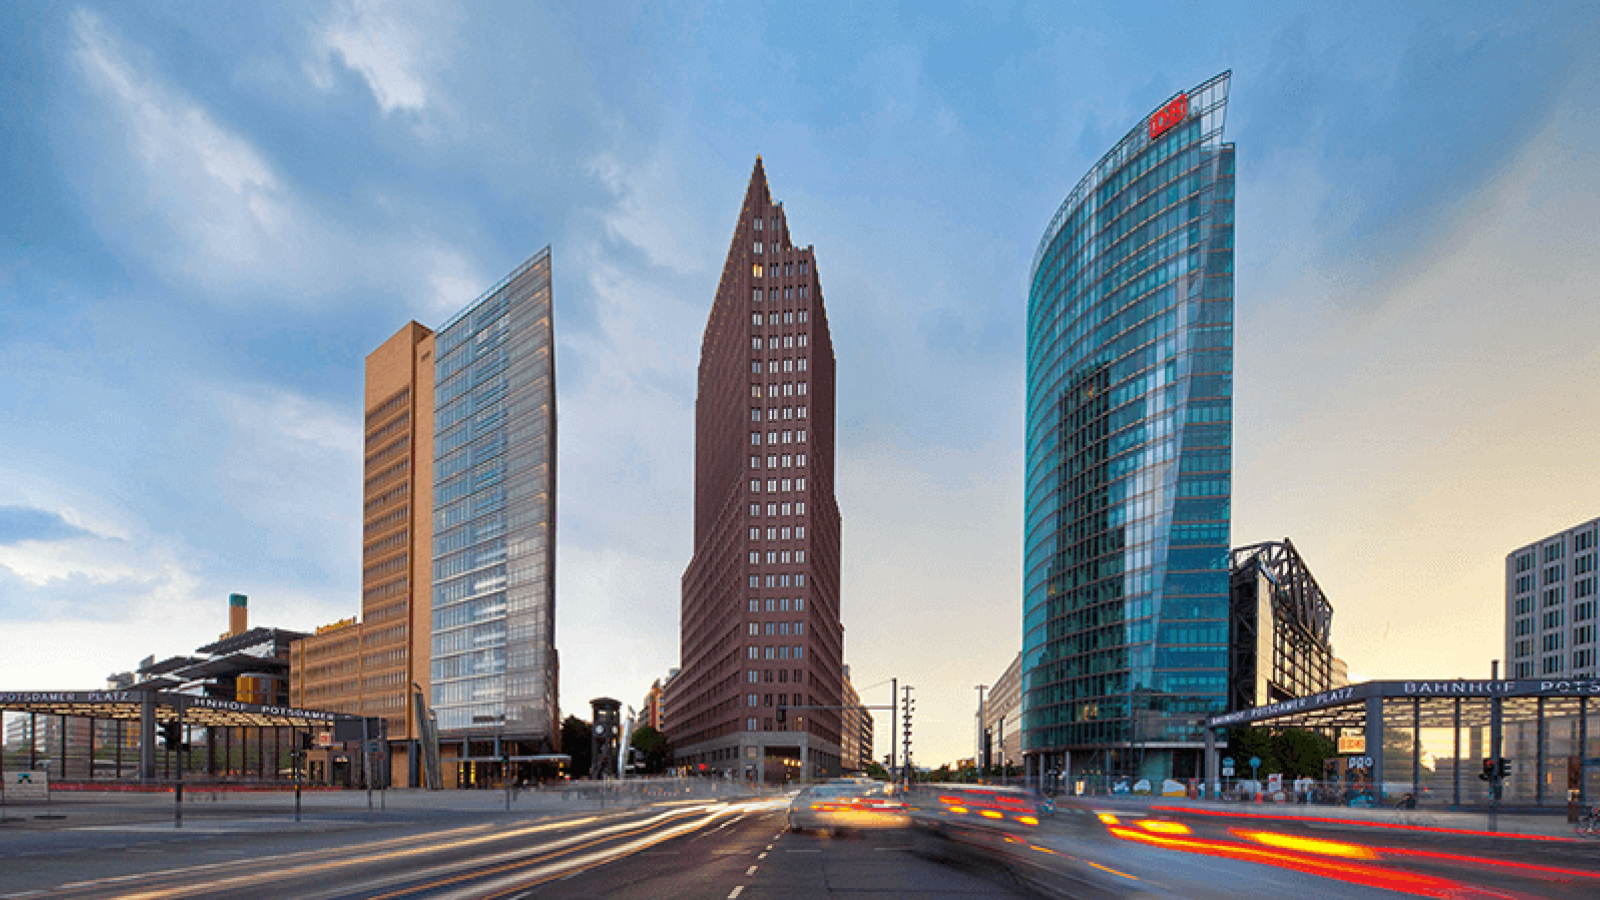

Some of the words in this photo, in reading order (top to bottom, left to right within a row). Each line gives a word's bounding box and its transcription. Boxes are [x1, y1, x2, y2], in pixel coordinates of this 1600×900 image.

[1152, 98, 1183, 134] DB
[1404, 681, 1516, 693] BAHNHOF
[0, 692, 77, 702] POTSDAMER
[87, 691, 132, 701] PLATZ
[1315, 686, 1355, 704] PLATZ
